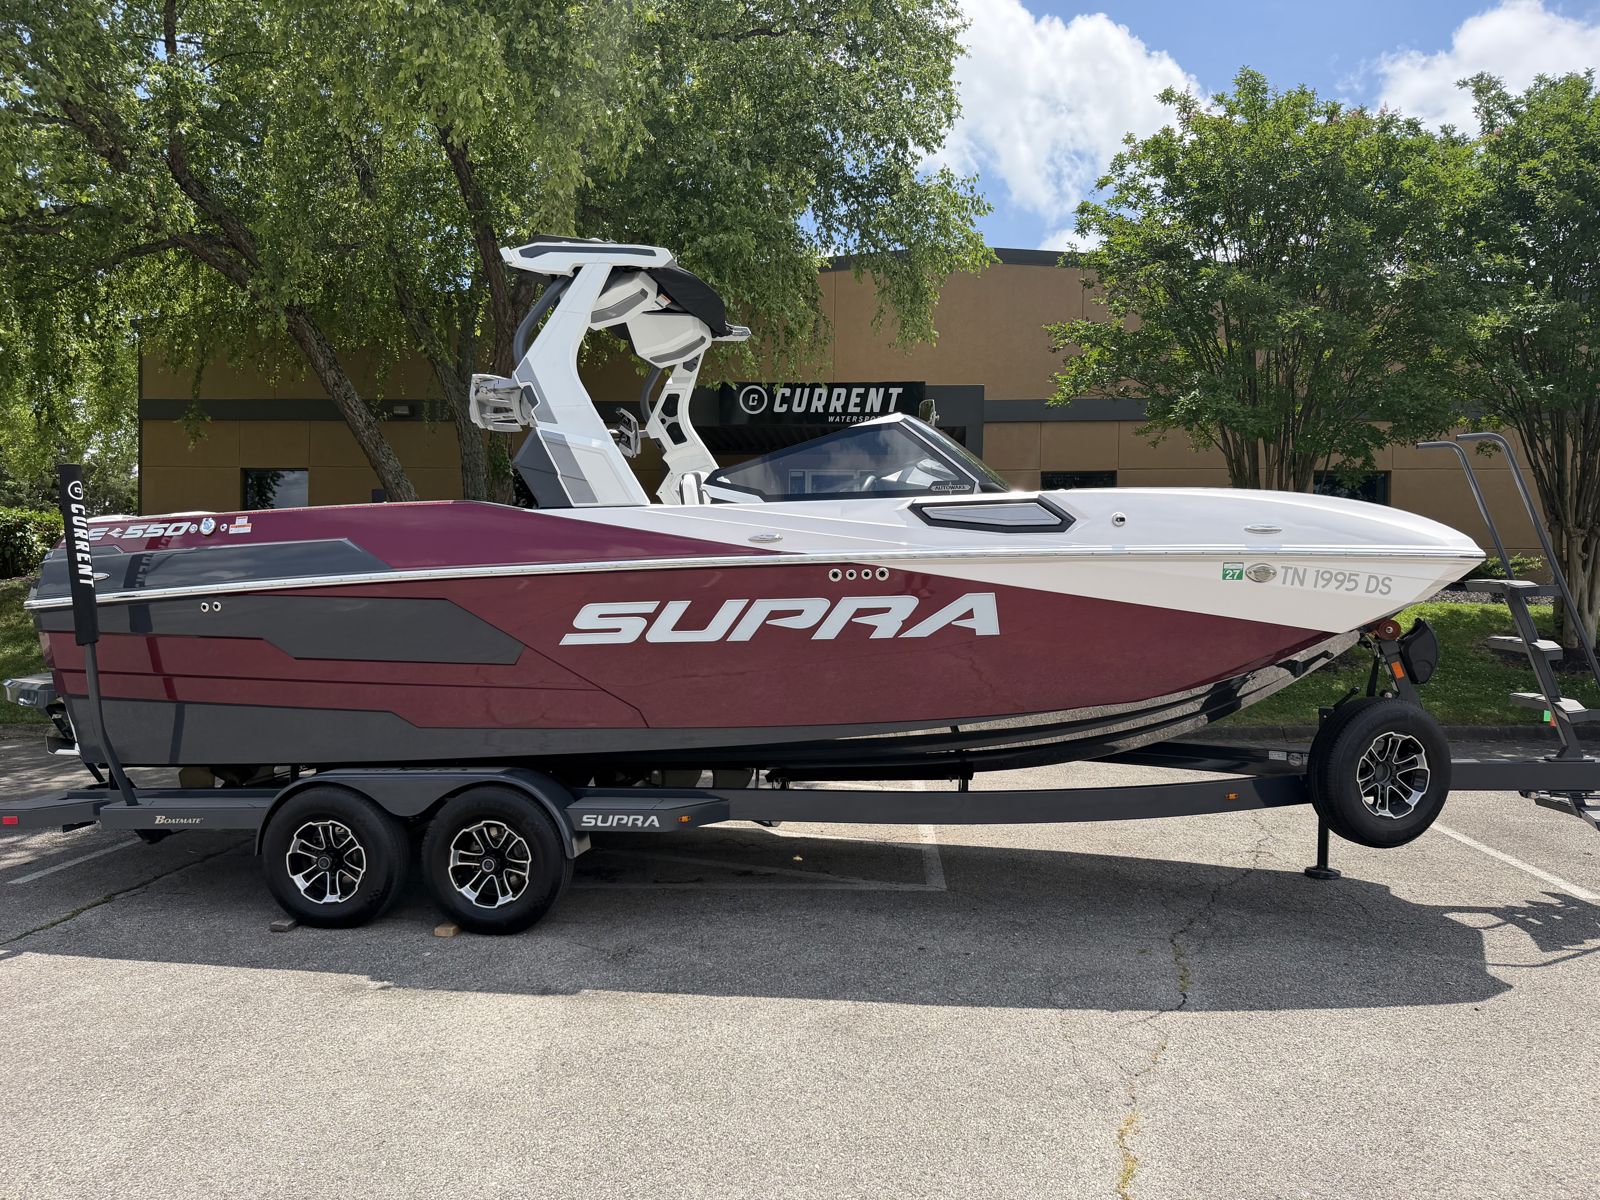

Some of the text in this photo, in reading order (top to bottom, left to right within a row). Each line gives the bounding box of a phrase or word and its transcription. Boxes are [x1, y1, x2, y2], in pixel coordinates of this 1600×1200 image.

[773, 387, 903, 413] CURRENT
[828, 415, 881, 423] WATERSPO
[71, 503, 95, 588] CURRENT
[1225, 569, 1241, 580] 27
[1281, 565, 1393, 596] TN 1995 DS
[558, 592, 1000, 646] SUPRA
[581, 814, 660, 828] SUPRA
